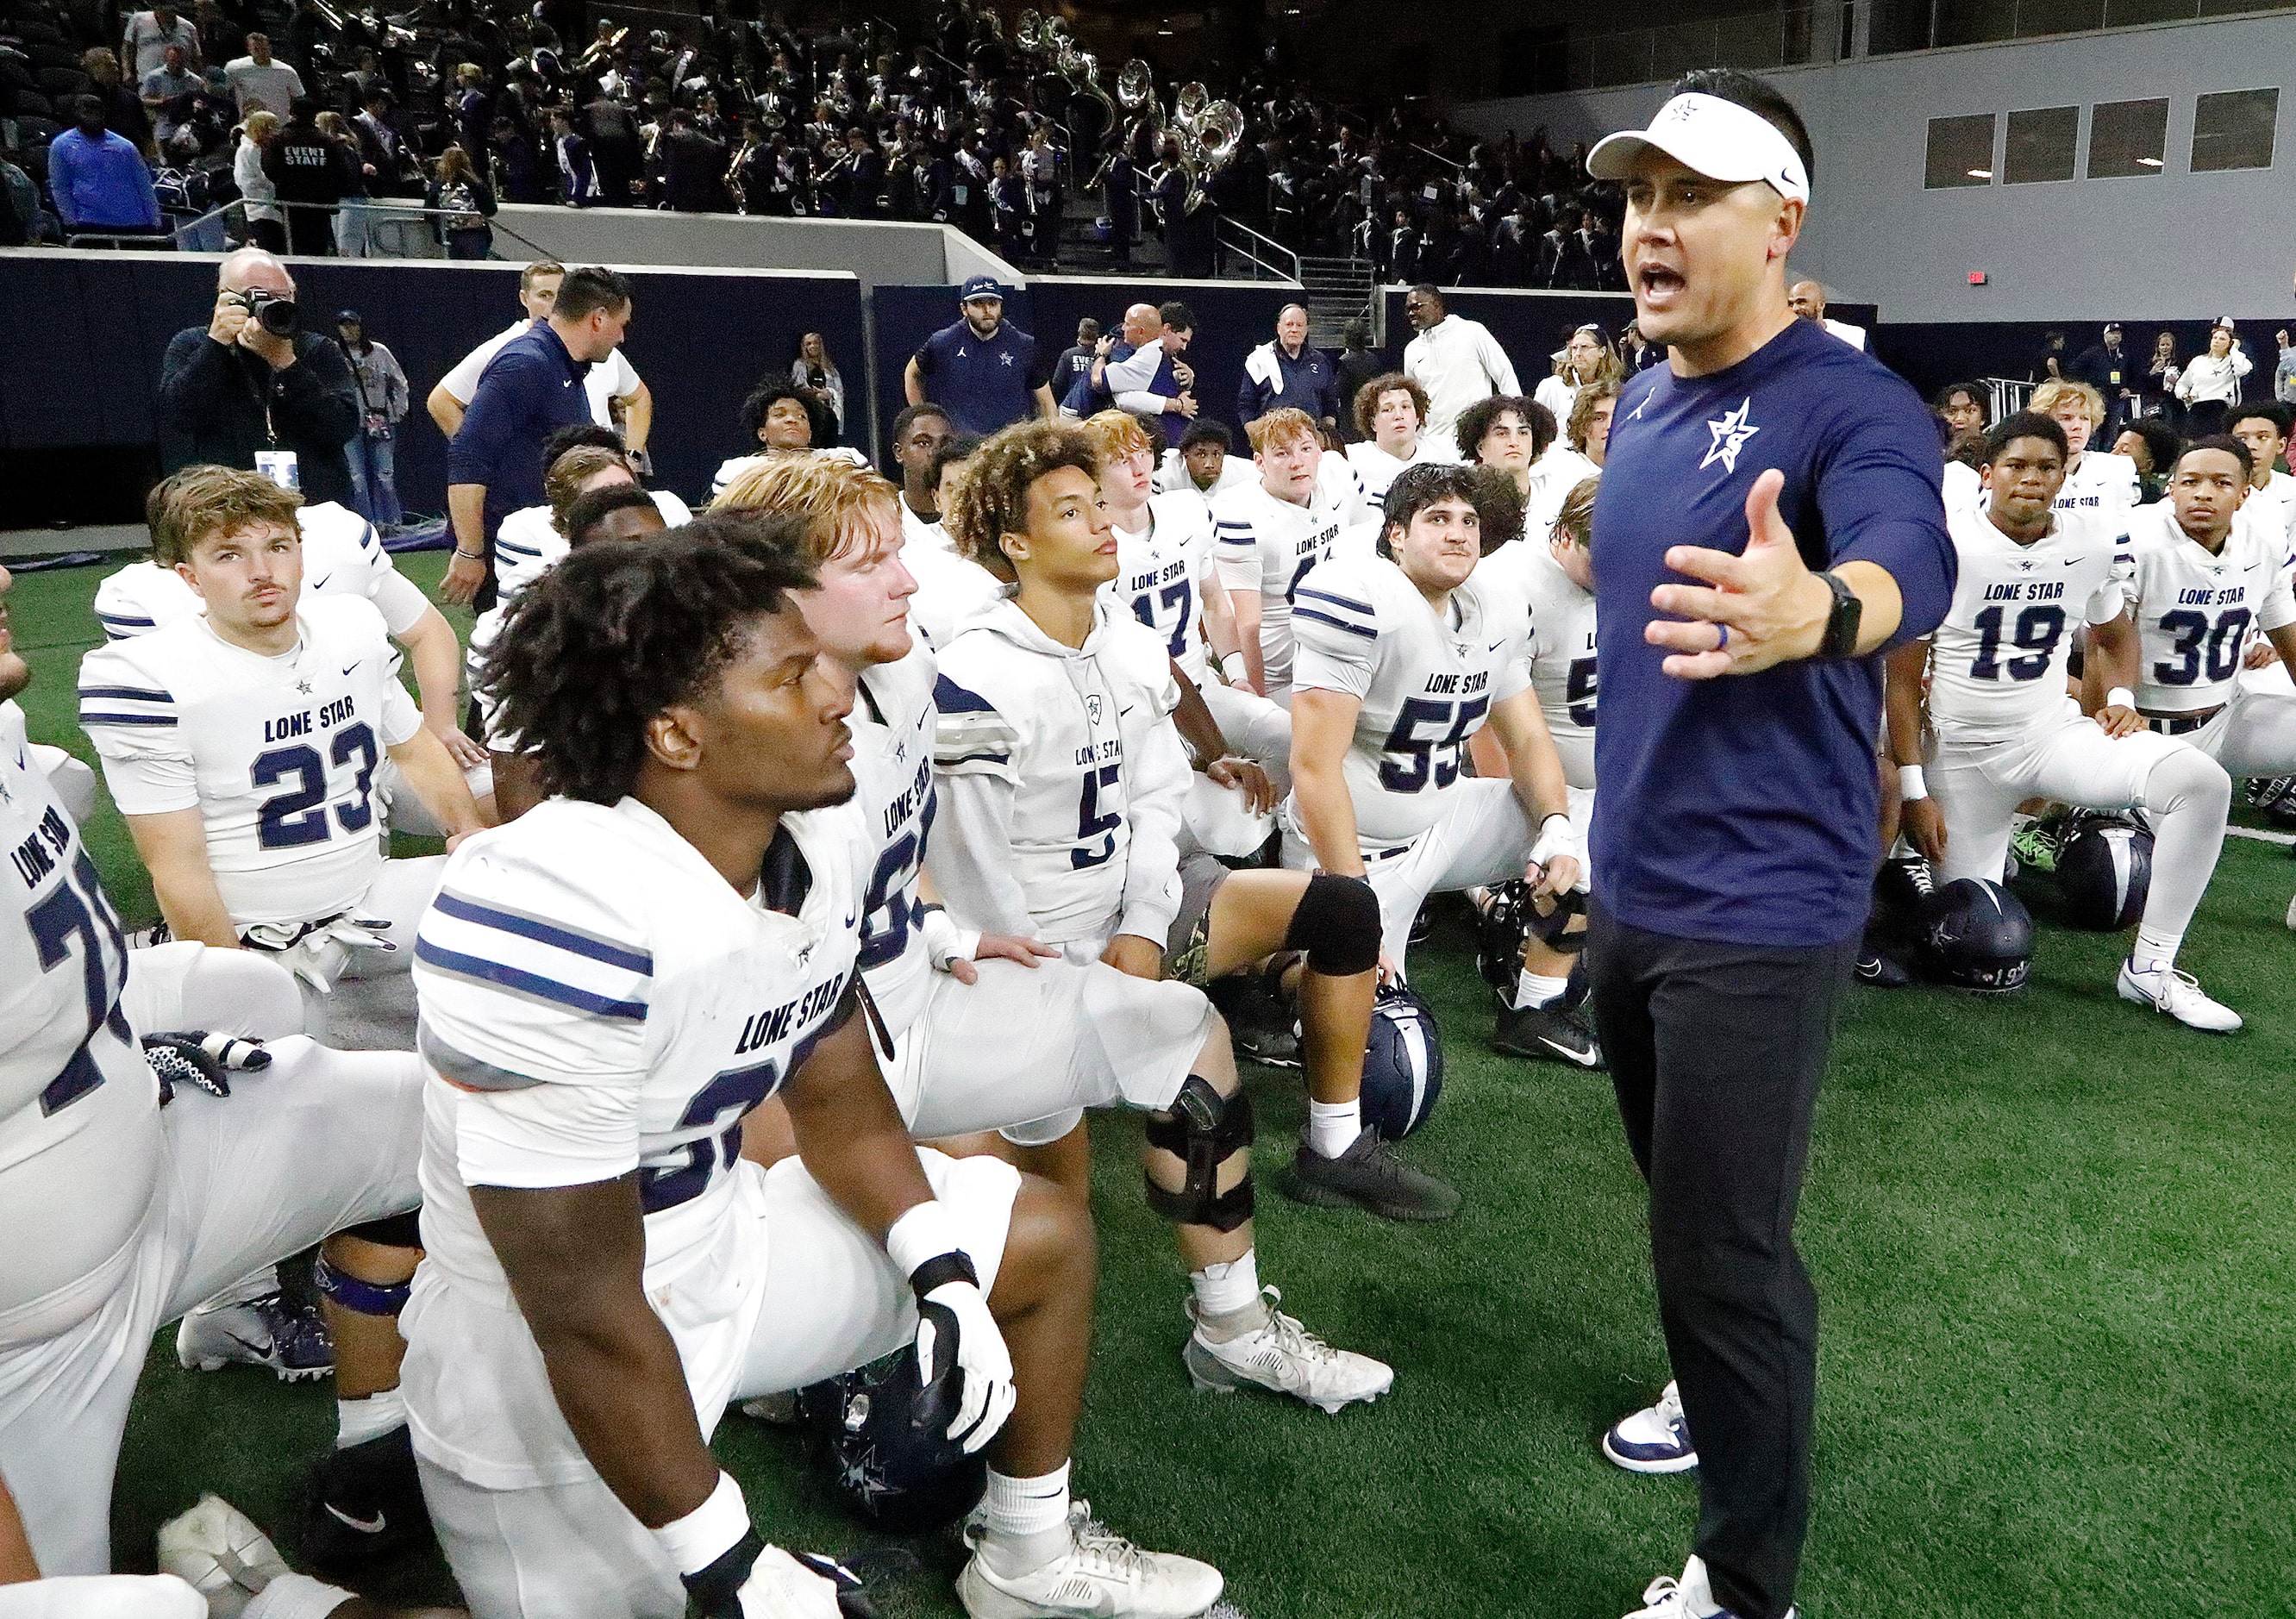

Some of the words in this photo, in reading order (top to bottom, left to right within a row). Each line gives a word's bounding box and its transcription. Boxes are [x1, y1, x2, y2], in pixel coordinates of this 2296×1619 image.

[285, 147, 325, 156] EVENT
[285, 156, 328, 166] STAFF
[1296, 535, 1317, 556] LONE
[1320, 524, 1339, 545] STAR
[1131, 571, 1159, 591] LONE
[1162, 559, 1186, 582] STAR
[1983, 583, 2023, 602] LONE
[2026, 582, 2065, 601] STAR
[2178, 588, 2214, 605] LONE
[2217, 586, 2245, 605] STAR
[2153, 607, 2253, 687] 30
[1424, 673, 1460, 694] LONE
[1461, 671, 1489, 695] STAR
[265, 710, 313, 743] LONE
[319, 695, 355, 728] STAR
[1378, 693, 1492, 794] 55
[249, 720, 378, 851] 23
[884, 786, 913, 839] LONE
[1070, 763, 1122, 870] 5
[10, 831, 55, 890] LONE
[735, 1000, 798, 1055] LONE
[797, 972, 843, 1029] STAR
